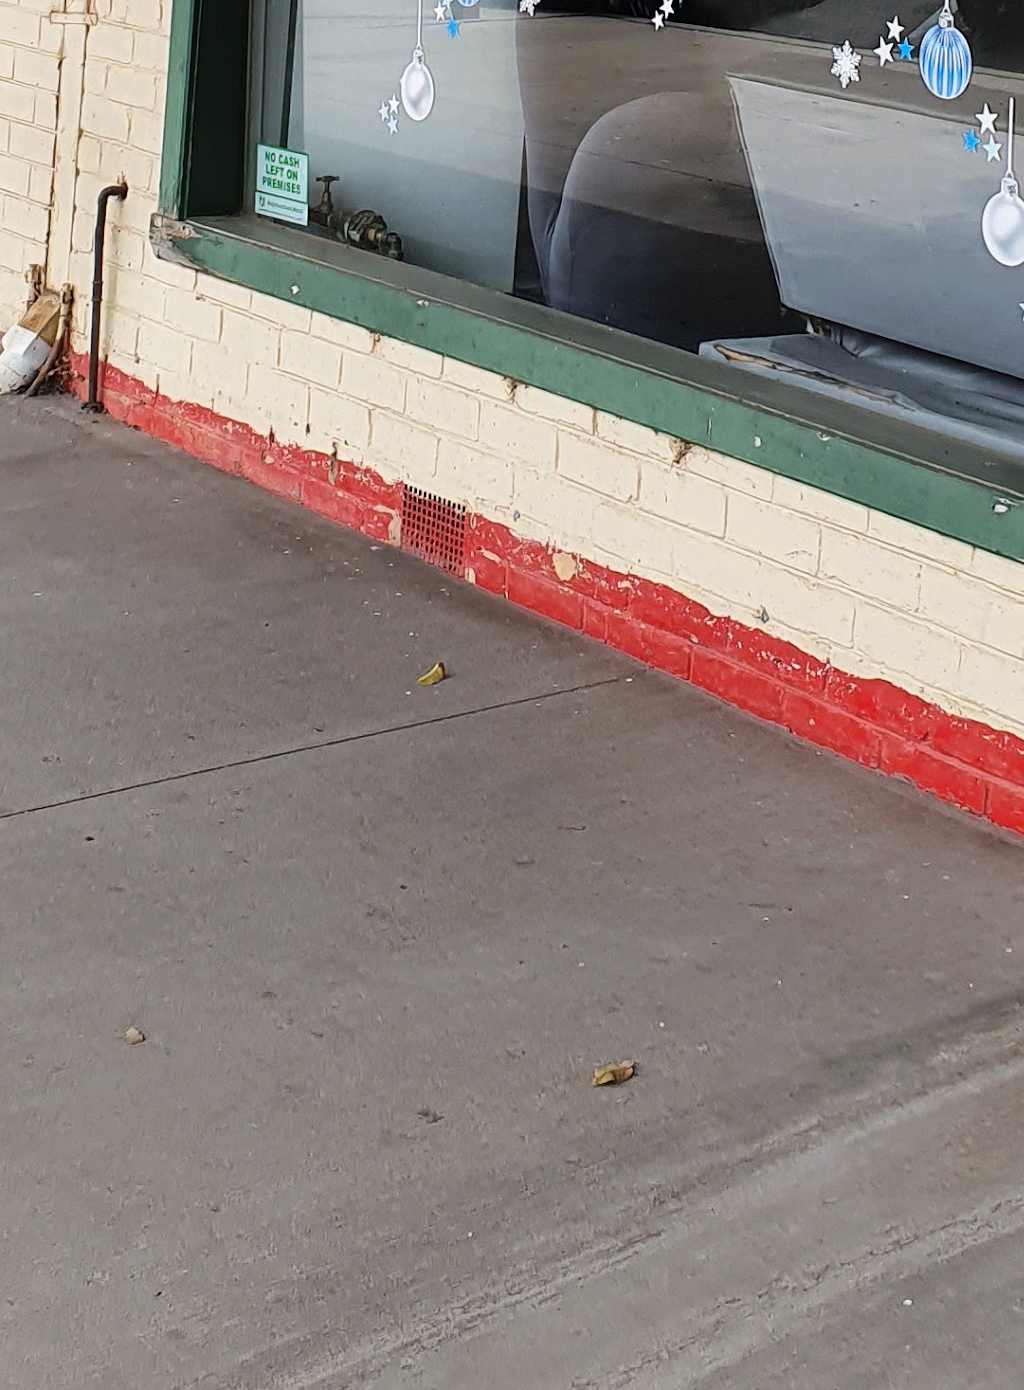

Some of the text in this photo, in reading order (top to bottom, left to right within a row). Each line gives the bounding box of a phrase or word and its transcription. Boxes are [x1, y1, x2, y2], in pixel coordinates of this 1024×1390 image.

[265, 152, 299, 168] NO CASH
[266, 165, 298, 181] LEFT ON
[262, 177, 300, 194] PREMISES
